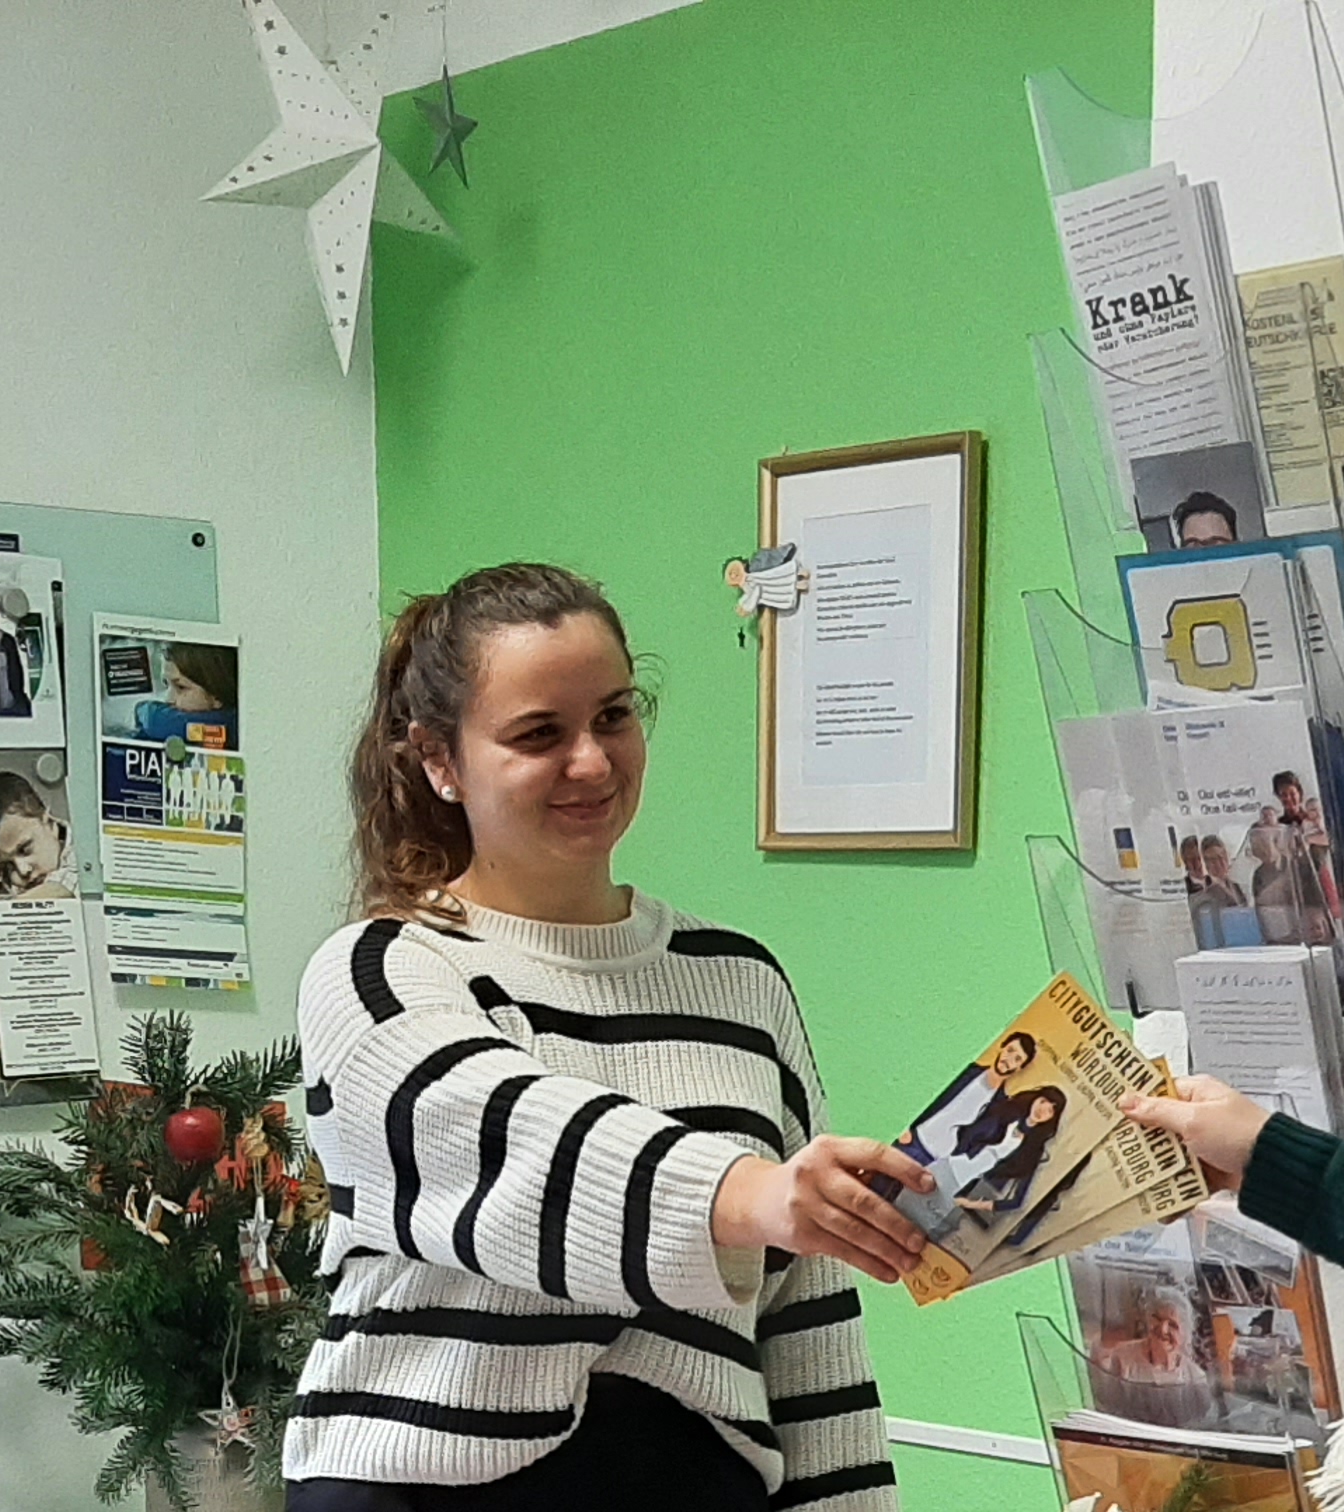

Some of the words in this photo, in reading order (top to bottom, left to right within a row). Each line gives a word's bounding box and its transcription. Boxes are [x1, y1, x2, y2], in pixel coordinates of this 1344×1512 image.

[1085, 273, 1195, 331] Krank
[125, 749, 162, 777] PIA
[1048, 979, 1153, 1096] CITYGUTSCHEIN
[1067, 1040, 1127, 1110] WÜRZBUR
[1114, 1118, 1155, 1185] RZBURG
